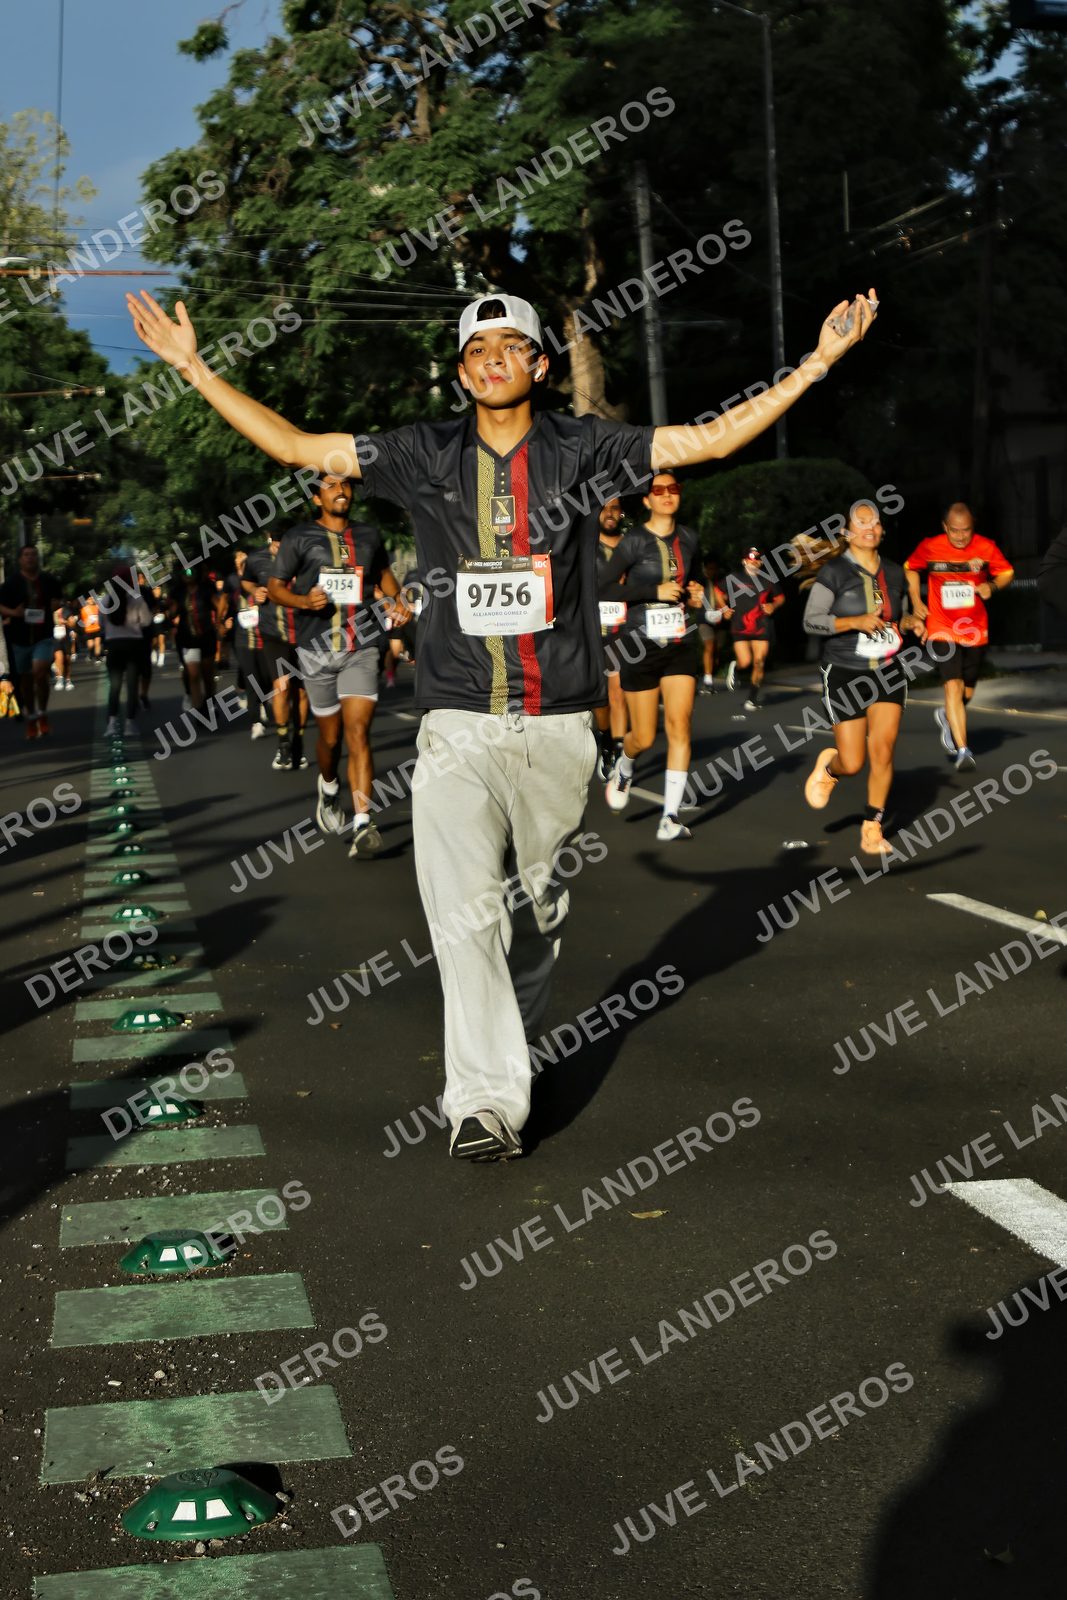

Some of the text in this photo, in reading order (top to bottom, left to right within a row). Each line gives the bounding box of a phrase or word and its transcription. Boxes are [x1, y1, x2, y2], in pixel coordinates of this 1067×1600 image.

[326, 579, 353, 590] 9154
[468, 582, 532, 608] 9756
[944, 588, 972, 599] 11062
[651, 612, 683, 625] 12972
